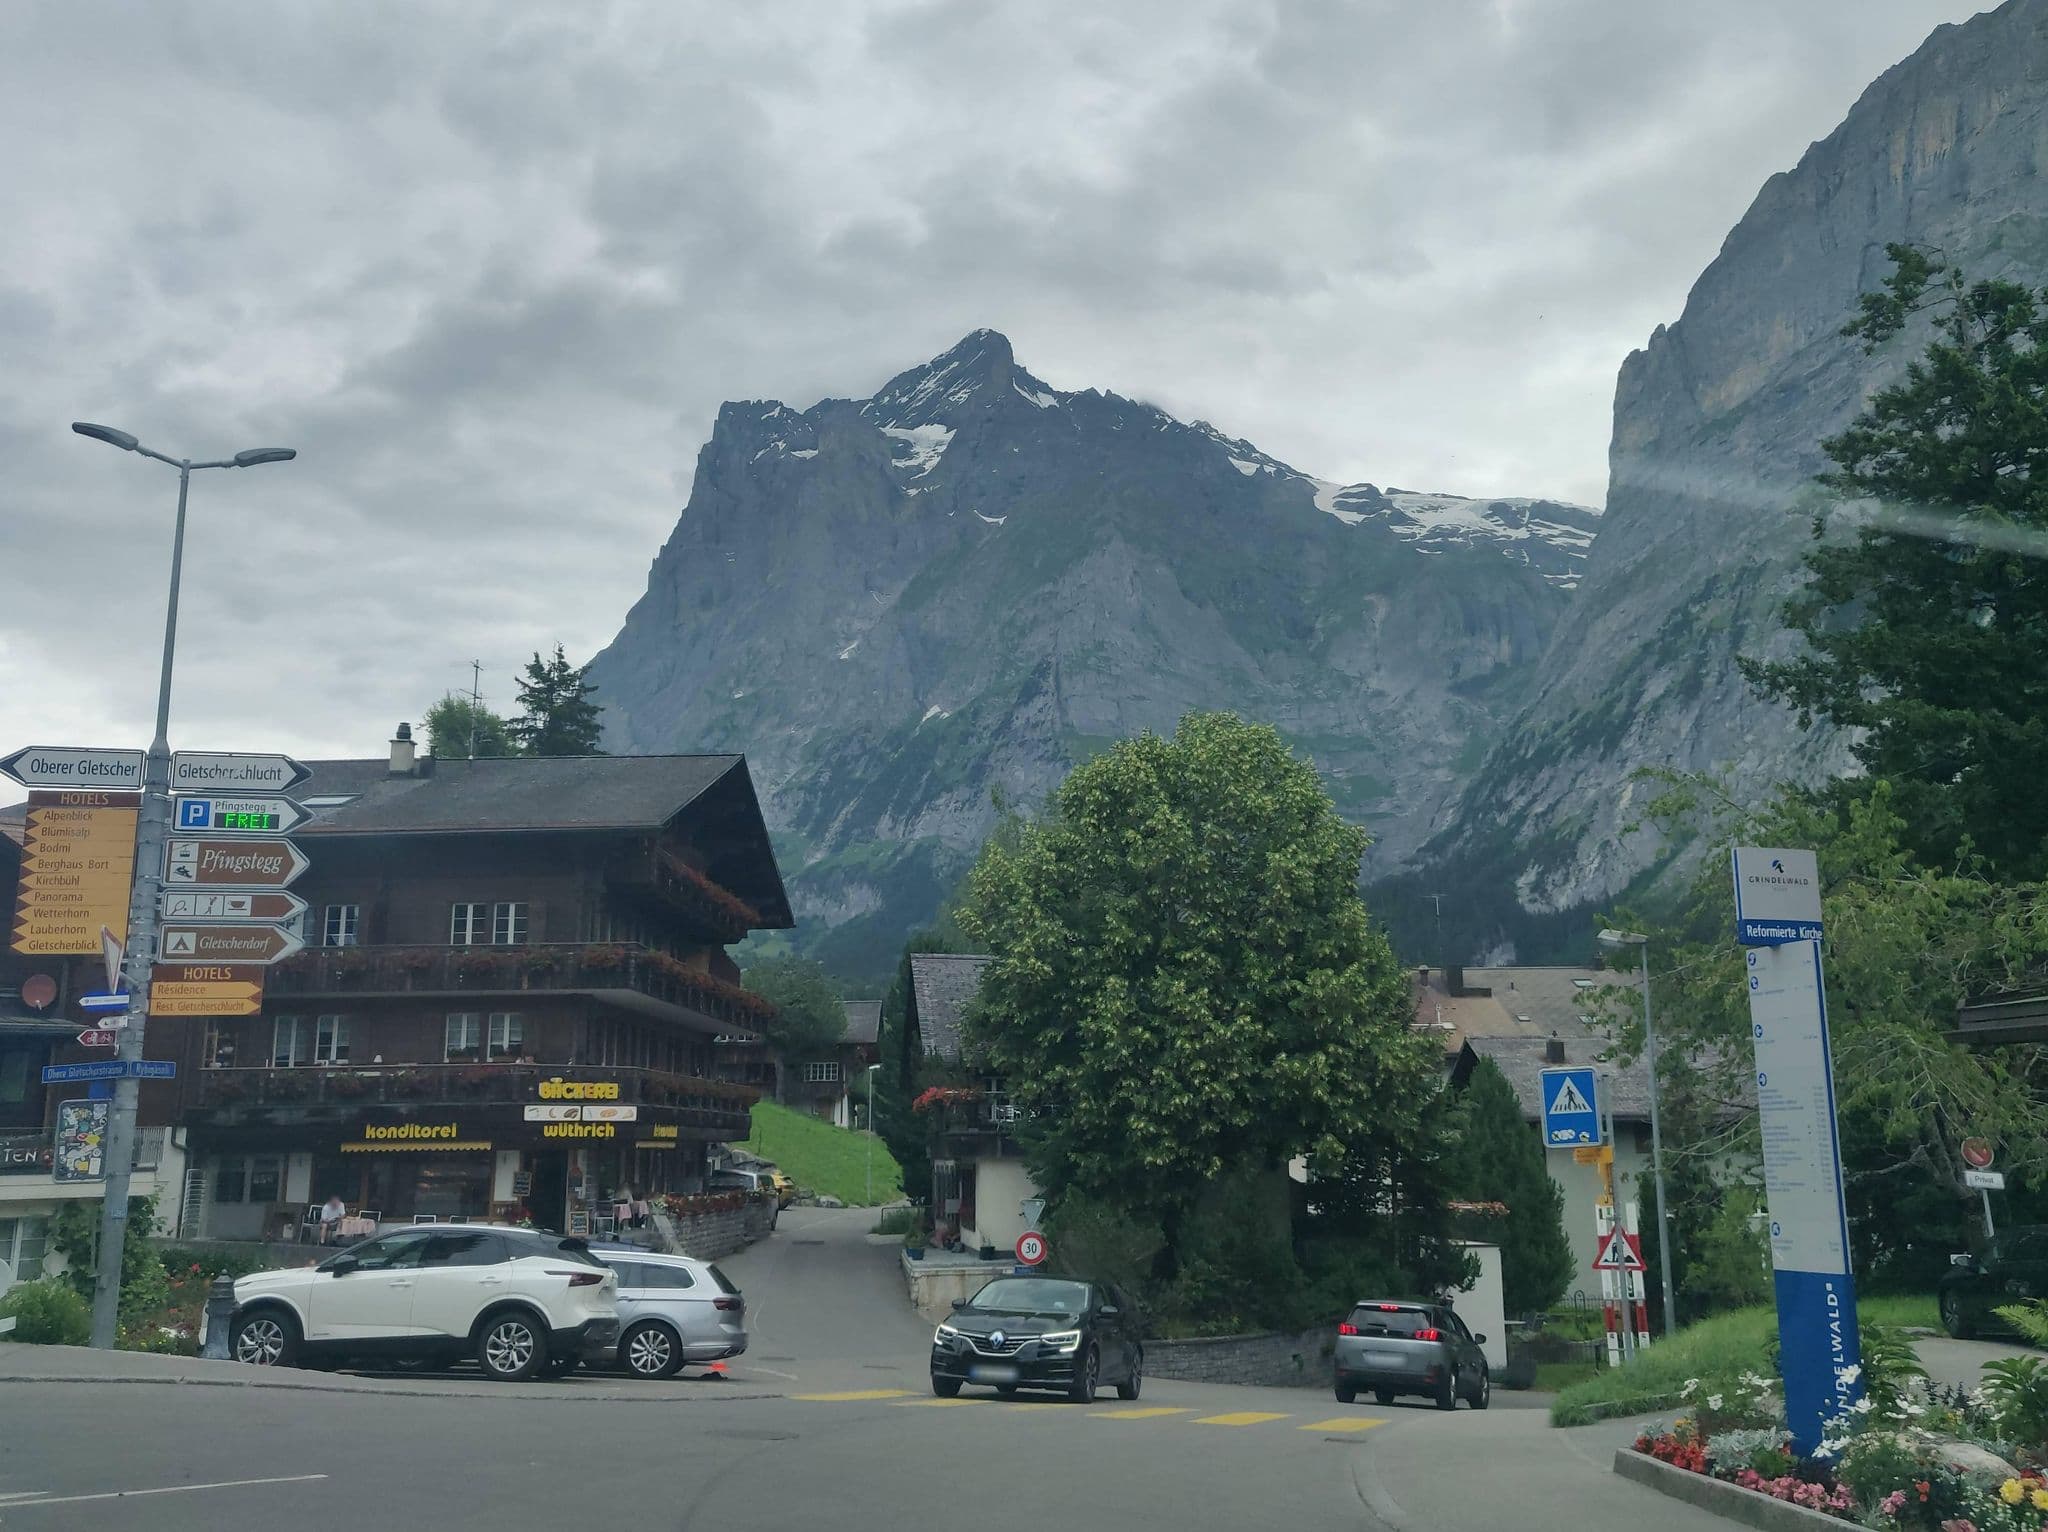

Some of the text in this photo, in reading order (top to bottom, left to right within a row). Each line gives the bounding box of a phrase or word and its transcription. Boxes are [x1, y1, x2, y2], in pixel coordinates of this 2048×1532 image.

[30, 758, 137, 776] Oberer Gletscher
[60, 793, 110, 805] HOTELS
[215, 801, 266, 813] Pfingstegg
[43, 810, 93, 822] Alpenblick
[224, 813, 270, 829] FREI
[40, 843, 71, 853] Bodmi
[38, 859, 109, 871] Berghaus Bort
[201, 849, 283, 874] Pfingstegg
[1748, 875, 1809, 886] GRINDELWALD
[34, 892, 83, 902] Panorama
[33, 908, 90, 918] Wetterhorn
[30, 924, 87, 935] Lauberhorn
[1746, 925, 1823, 940] Reformierte Kirche
[28, 940, 97, 950] Gletscherblick
[199, 936, 271, 952] Gletscherdorf
[183, 967, 232, 980] HOTELS
[157, 983, 207, 995] Résidence
[365, 1123, 457, 1139] konditorei
[1025, 1242, 1037, 1254] 30
